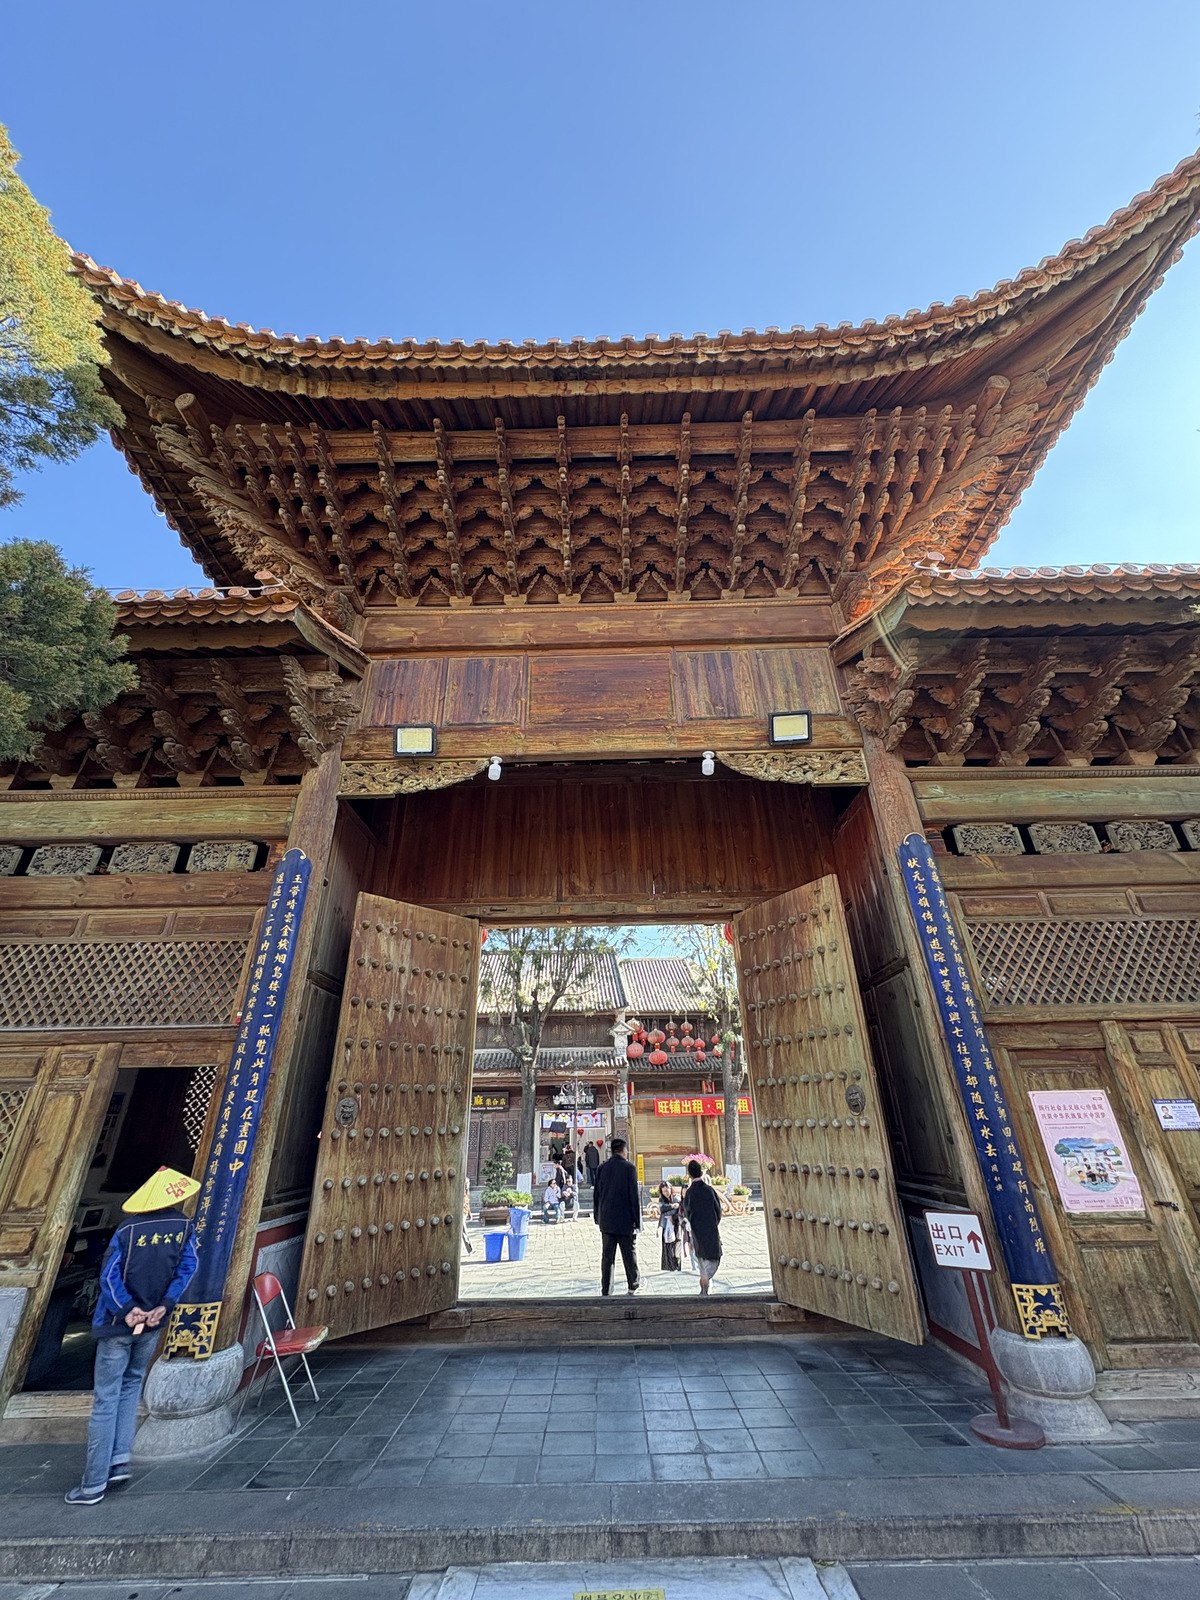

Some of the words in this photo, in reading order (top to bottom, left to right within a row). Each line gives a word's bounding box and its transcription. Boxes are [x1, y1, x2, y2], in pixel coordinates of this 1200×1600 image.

[657, 1098, 750, 1114] 旺铺出租·可租
[930, 1222, 963, 1240] 出口
[934, 1243, 965, 1257] EXIT
